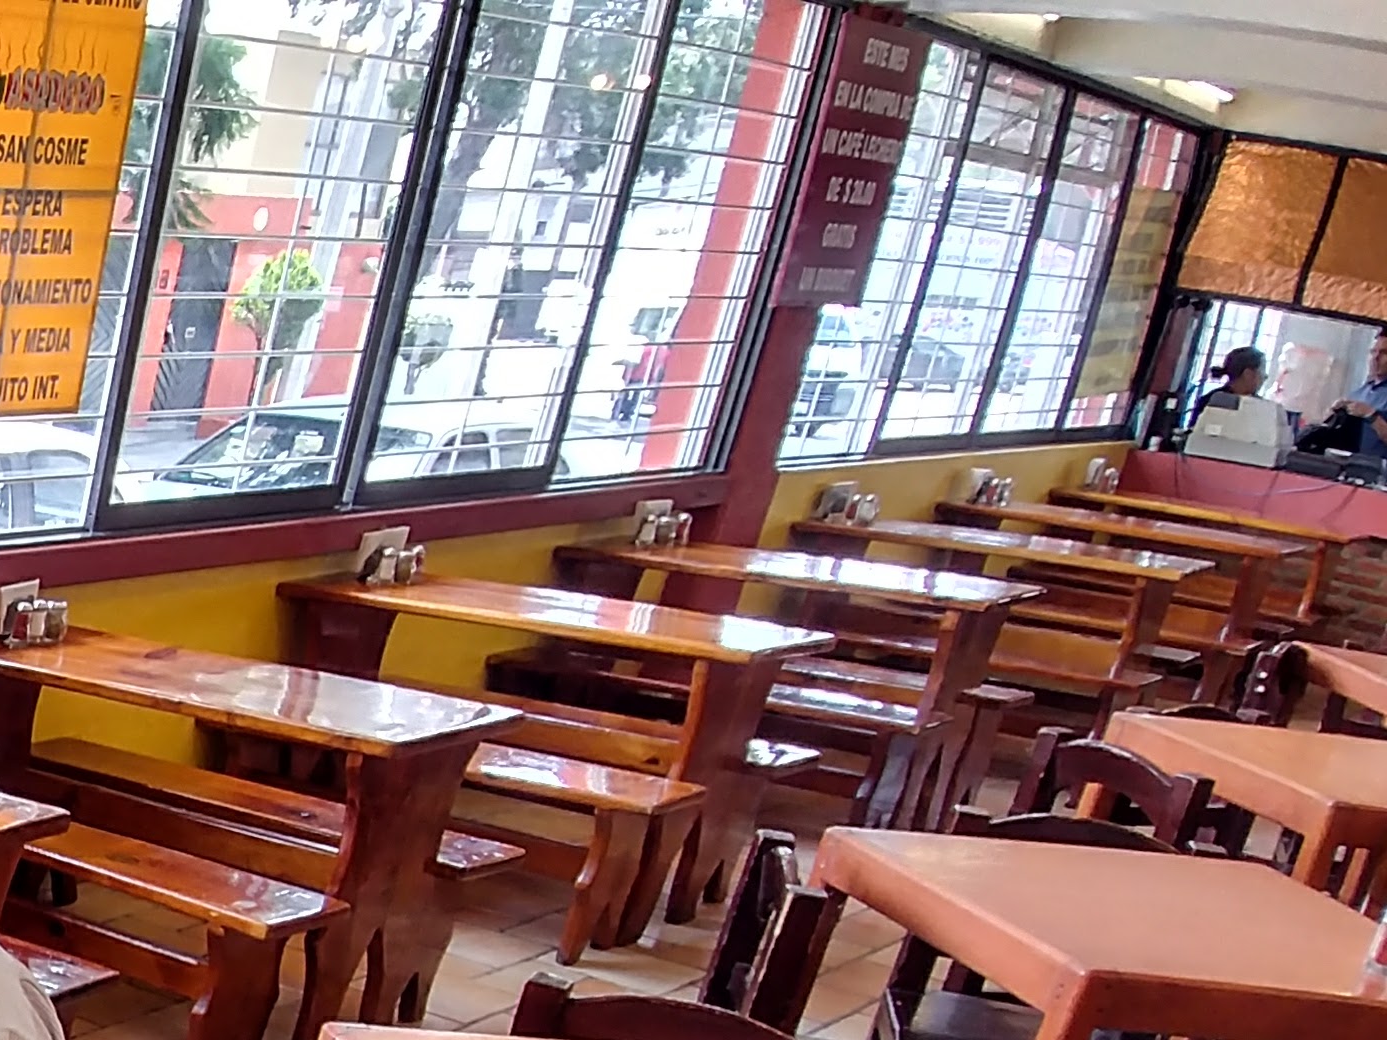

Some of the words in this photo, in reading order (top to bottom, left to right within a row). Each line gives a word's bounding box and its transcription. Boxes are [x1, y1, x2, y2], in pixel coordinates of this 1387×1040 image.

[863, 37, 891, 68] ESTE
[5, 65, 105, 115] ASADERO
[834, 80, 852, 107] EN
[849, 84, 864, 109] LA
[33, 137, 89, 166] COSME
[837, 128, 865, 158] CAFÉ
[2, 188, 63, 217] ESPERA
[826, 176, 844, 202] DE
[9, 329, 22, 354] Y
[23, 327, 71, 353] MEDIA
[32, 375, 60, 400] INT.
